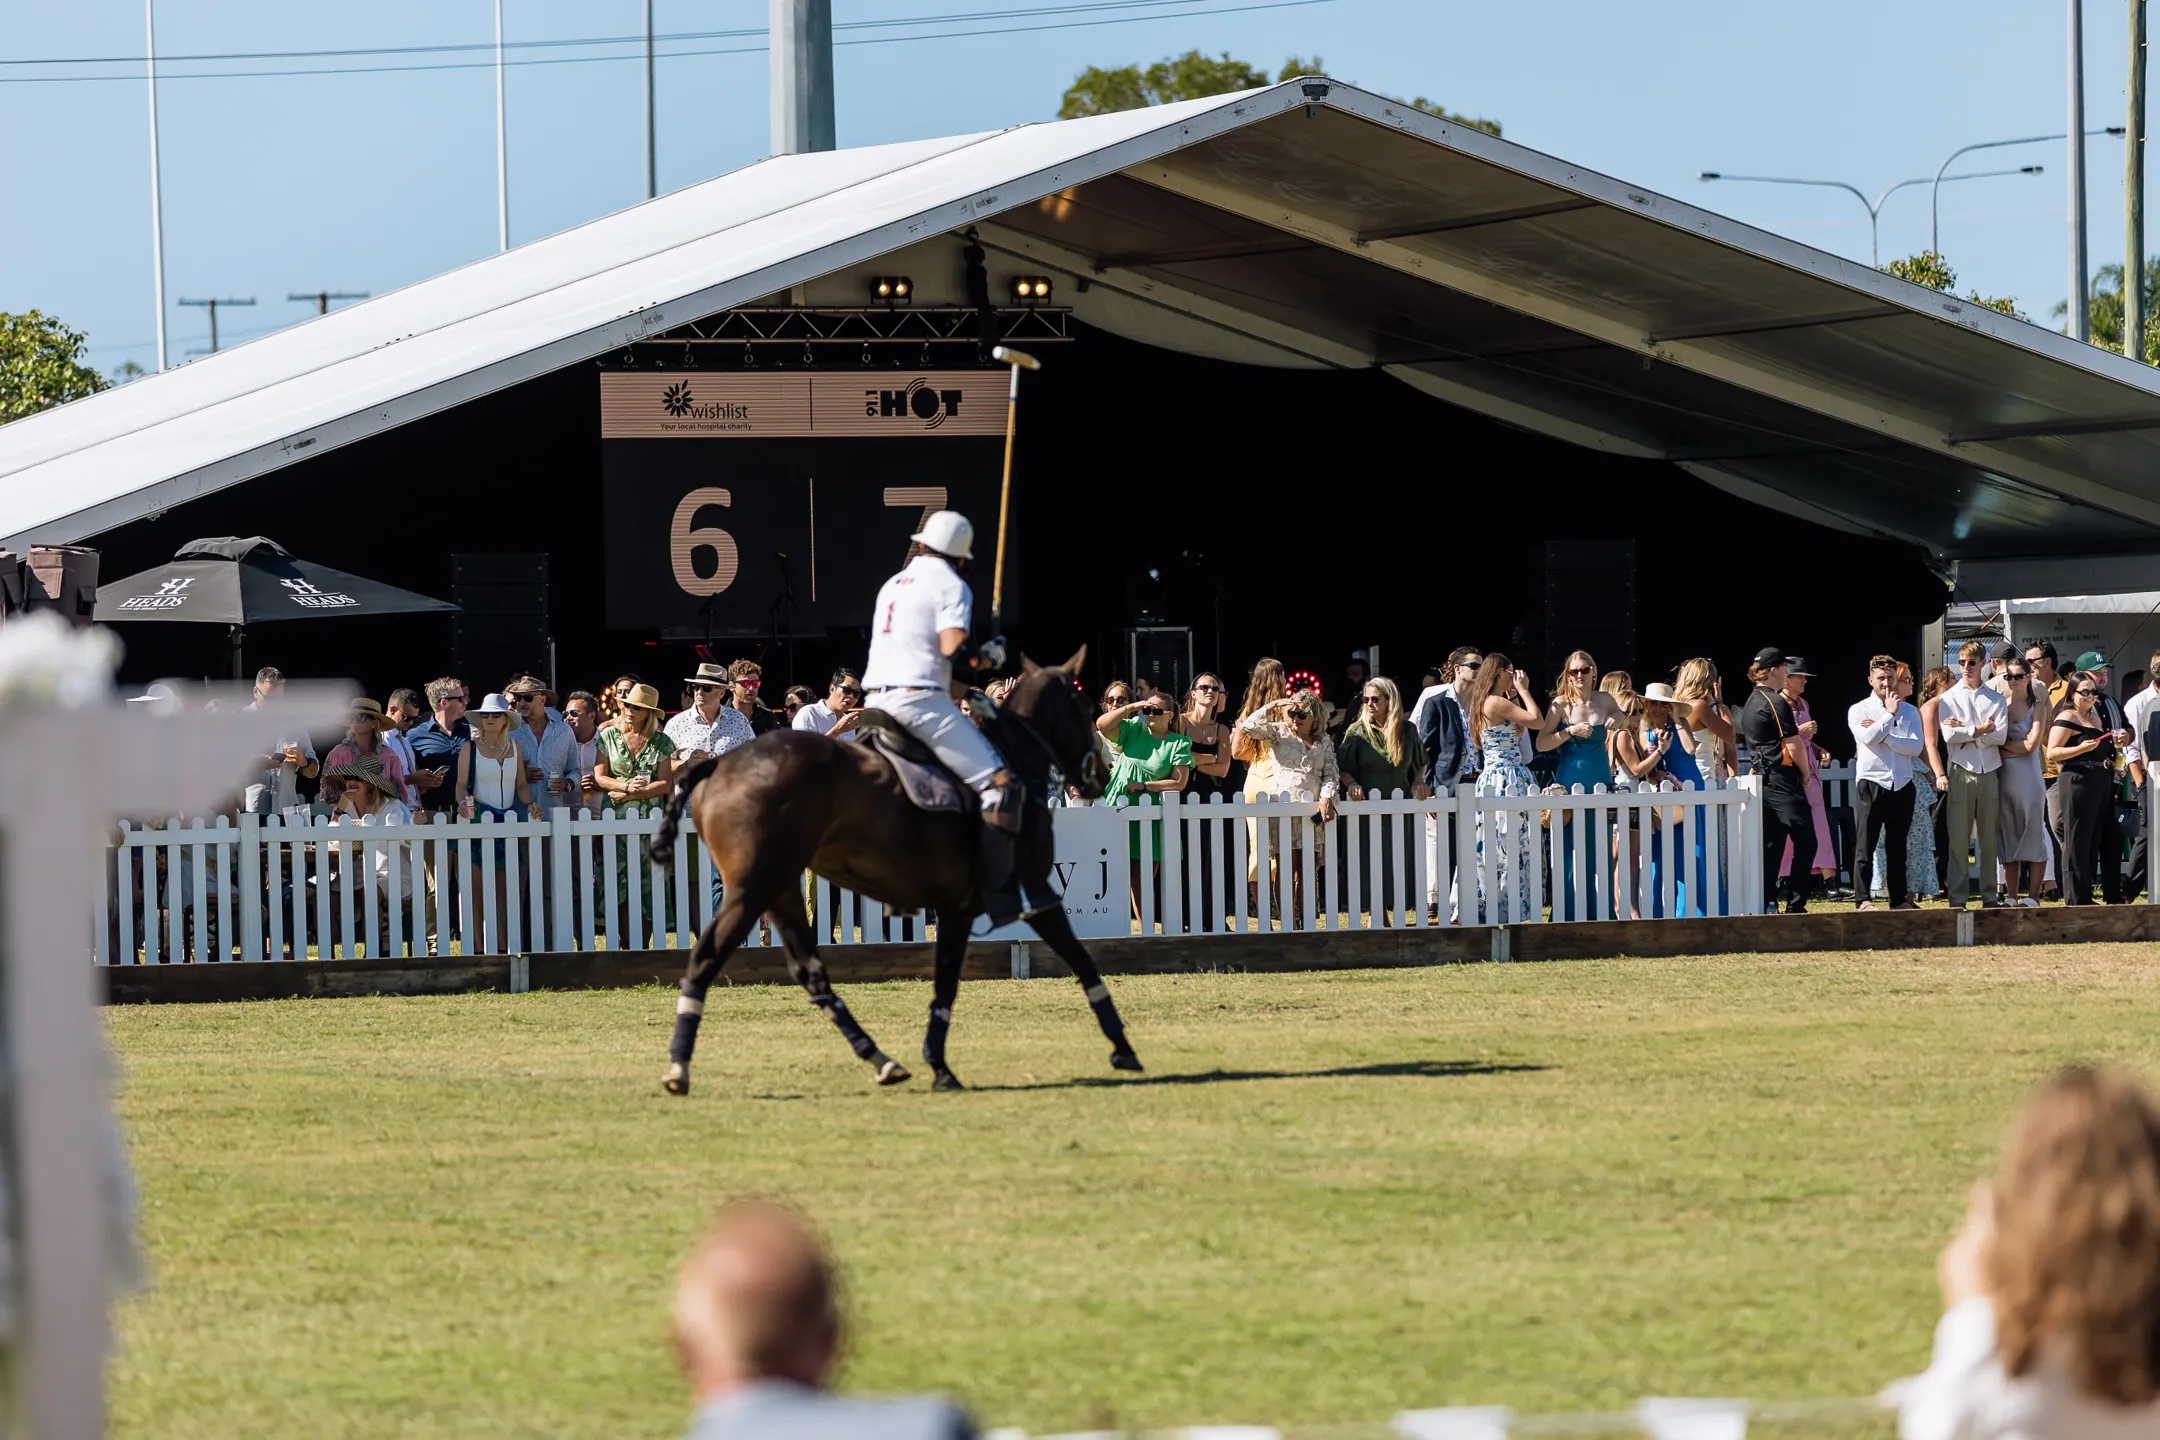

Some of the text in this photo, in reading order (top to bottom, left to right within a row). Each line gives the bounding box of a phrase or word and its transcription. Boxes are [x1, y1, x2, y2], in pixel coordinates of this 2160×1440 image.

[691, 402, 748, 418] wishlist
[865, 390, 878, 416] 91.1
[880, 386, 962, 419] HOT
[678, 422, 696, 430] local
[697, 422, 726, 431] hospital
[727, 422, 752, 431] charity
[883, 486, 947, 570] 7
[670, 486, 738, 597] 6
[118, 596, 188, 608] HEADS
[290, 594, 356, 606] HEADS
[882, 600, 896, 633] 1
[1065, 906, 1108, 915] OM.AU
